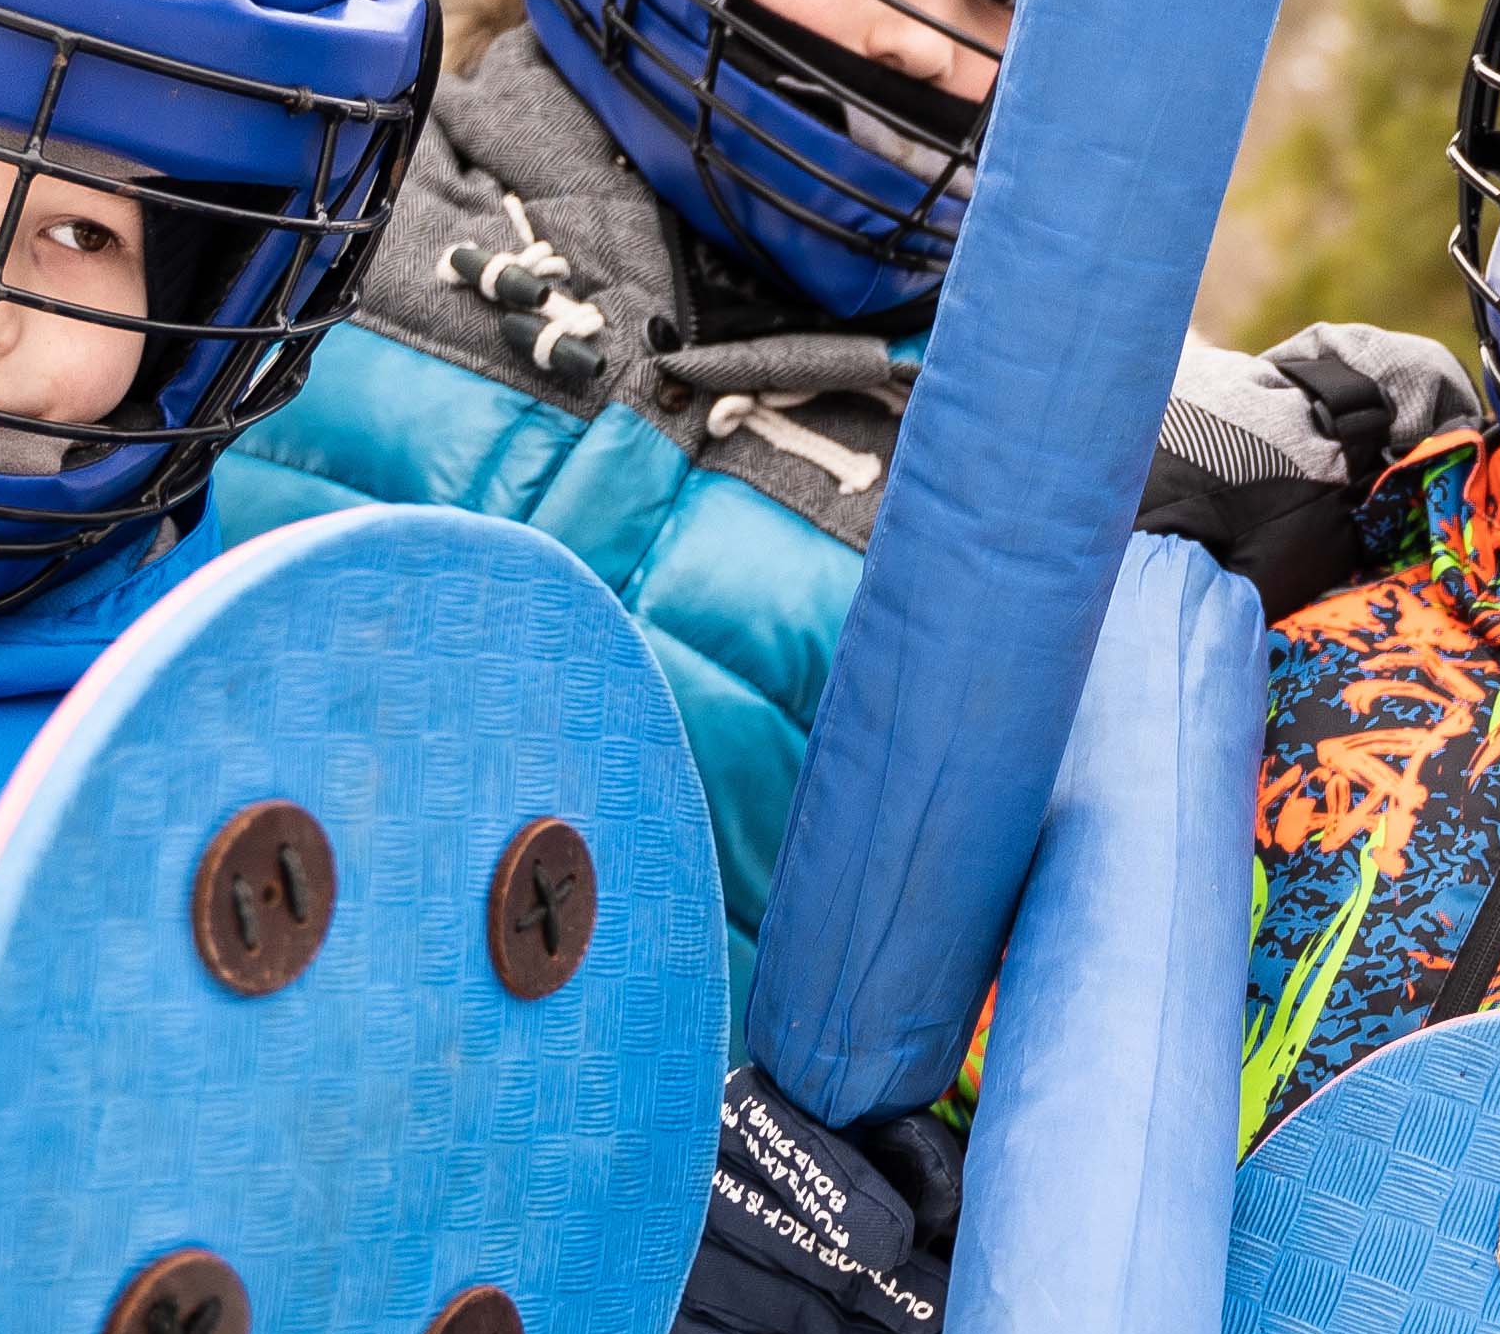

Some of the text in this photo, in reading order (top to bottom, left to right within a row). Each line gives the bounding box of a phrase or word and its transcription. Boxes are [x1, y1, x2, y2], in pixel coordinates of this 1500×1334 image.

[745, 1190, 765, 1216] IS
[762, 1208, 817, 1254] PACK
[817, 1242, 934, 1320] OUTOR
